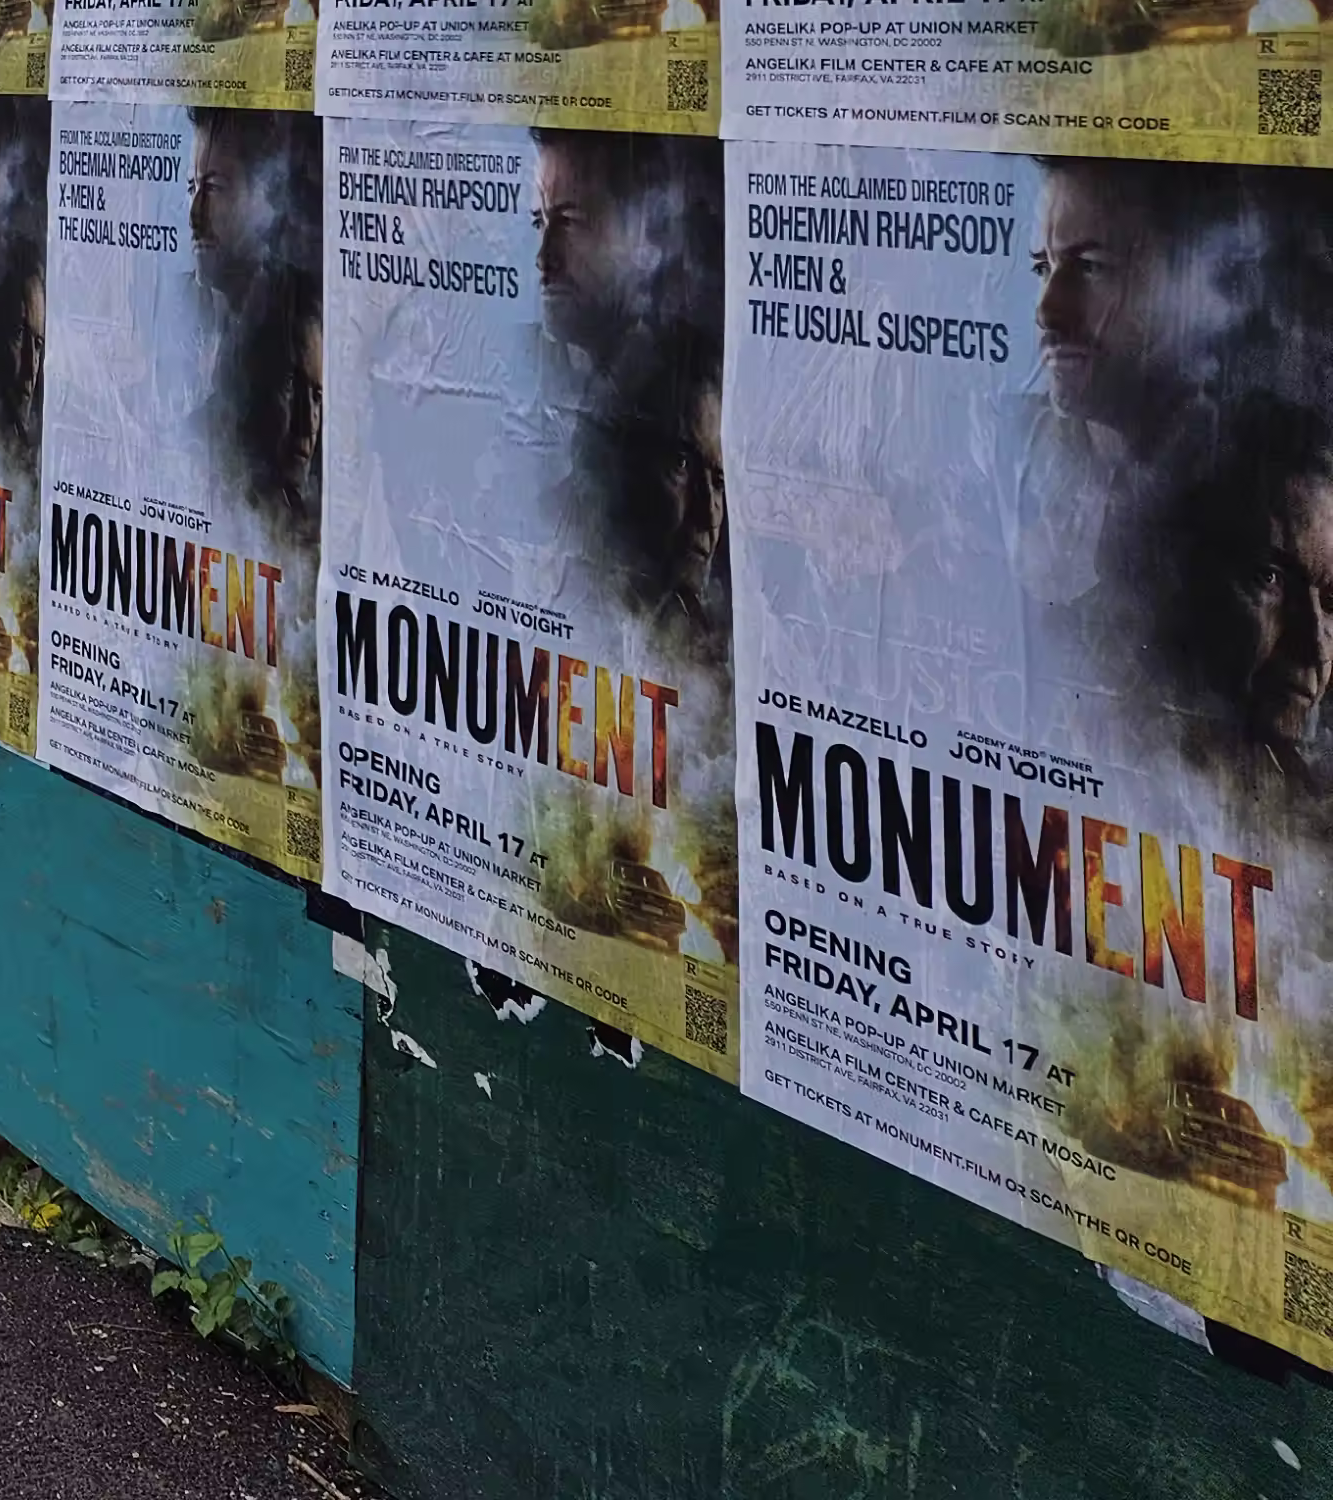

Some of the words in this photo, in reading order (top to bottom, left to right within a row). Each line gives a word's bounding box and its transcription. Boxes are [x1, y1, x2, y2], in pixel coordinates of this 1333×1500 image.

[747, 172, 787, 196] FROM
[789, 174, 817, 198] THE
[911, 178, 989, 206] DIRECTOR
[993, 182, 1015, 207] OF
[747, 204, 869, 247] BOHEMIAN
[875, 210, 1015, 258] RHAPSODY
[367, 252, 425, 288] USUAL
[429, 260, 519, 299] SUSPECTS
[748, 250, 823, 293] X-MEN
[829, 258, 847, 296] &
[747, 299, 790, 338] THE
[795, 304, 871, 348] USUAL
[877, 311, 1010, 364] SUSPECTS
[49, 503, 284, 668] MONUMENT
[51, 630, 121, 670] OPENING
[335, 590, 681, 810] MONUMENT
[757, 688, 803, 714] JOE
[807, 699, 928, 750] MAZZELLO
[338, 742, 441, 795] OPENING
[949, 741, 1002, 771] JON
[1007, 756, 1105, 798] VOIGHT
[957, 729, 1006, 750] ACADEMY
[1049, 754, 1093, 774] WINNER
[339, 768, 421, 820] FRIDAY,
[425, 802, 491, 848] APRIL
[497, 832, 525, 858] 17
[755, 720, 1274, 1022] MONUMENT
[764, 864, 826, 894] BASED
[837, 890, 863, 909] ON
[877, 905, 887, 918] A
[899, 912, 953, 942] TRUE
[965, 936, 1035, 970] STORY
[765, 909, 911, 984] OPENING
[764, 998, 782, 1014] 550
[783, 1006, 809, 1024] PENN
[811, 1018, 823, 1030] ST
[843, 1030, 915, 1070] WASHINGTON,
[917, 1064, 933, 1077] DC
[935, 1070, 967, 1090] 20002
[764, 984, 841, 1026] ANGELIKA
[845, 1016, 905, 1050] POP-UP
[909, 1043, 929, 1061] AT
[933, 1051, 988, 1086] UNION
[993, 1076, 1066, 1117] MARKET
[765, 942, 881, 1014] FRIDAY,
[889, 994, 991, 1056] APRIL
[1002, 1038, 1039, 1071] 17
[1046, 1064, 1076, 1088] AT
[764, 1034, 787, 1052] 2911
[789, 1045, 833, 1071] DISTRICT
[833, 1066, 857, 1083] AVE,
[901, 1094, 917, 1108] VA
[919, 1101, 949, 1122] 22031
[765, 1020, 842, 1063] ANGELIKA
[845, 1054, 881, 1080] FILM
[885, 1072, 950, 1110] CENTER
[953, 1100, 965, 1116] &
[969, 1107, 1013, 1136] CAFE
[1014, 1128, 1039, 1147] AT
[1042, 1138, 1117, 1182] MOSAIC
[764, 1069, 791, 1088] GET
[793, 1082, 852, 1118] TICKETS
[854, 1110, 873, 1126] AT
[875, 1118, 1001, 1186] MONUMENT.FILM
[1029, 1189, 1075, 1218] SCAN
[1075, 1210, 1111, 1237] THE
[1115, 1228, 1140, 1250] QR
[1144, 1242, 1191, 1276] CODE
[1286, 1220, 1304, 1240] R
